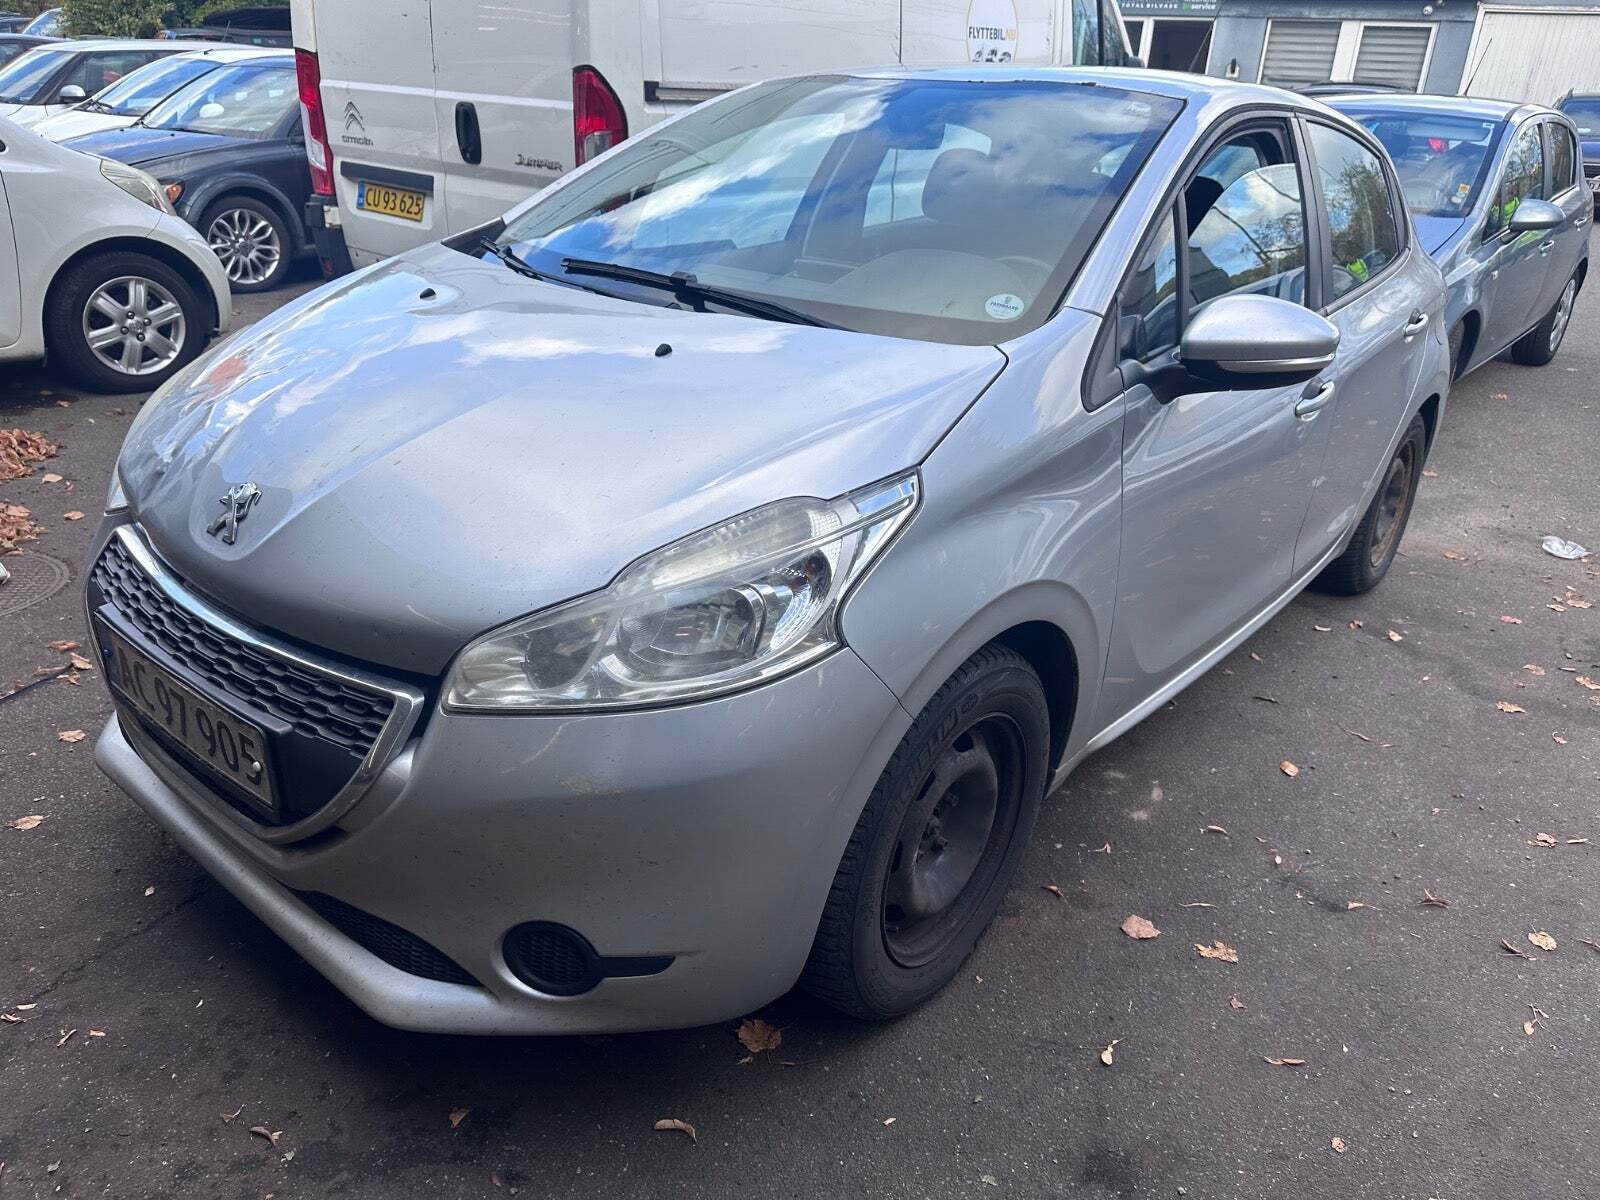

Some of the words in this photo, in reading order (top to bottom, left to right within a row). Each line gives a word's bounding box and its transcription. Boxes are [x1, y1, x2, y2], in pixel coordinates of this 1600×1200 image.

[366, 188, 381, 207] CU
[383, 190, 398, 211] 93
[400, 192, 422, 216] 625
[154, 676, 187, 738] 97
[195, 706, 262, 786] 905
